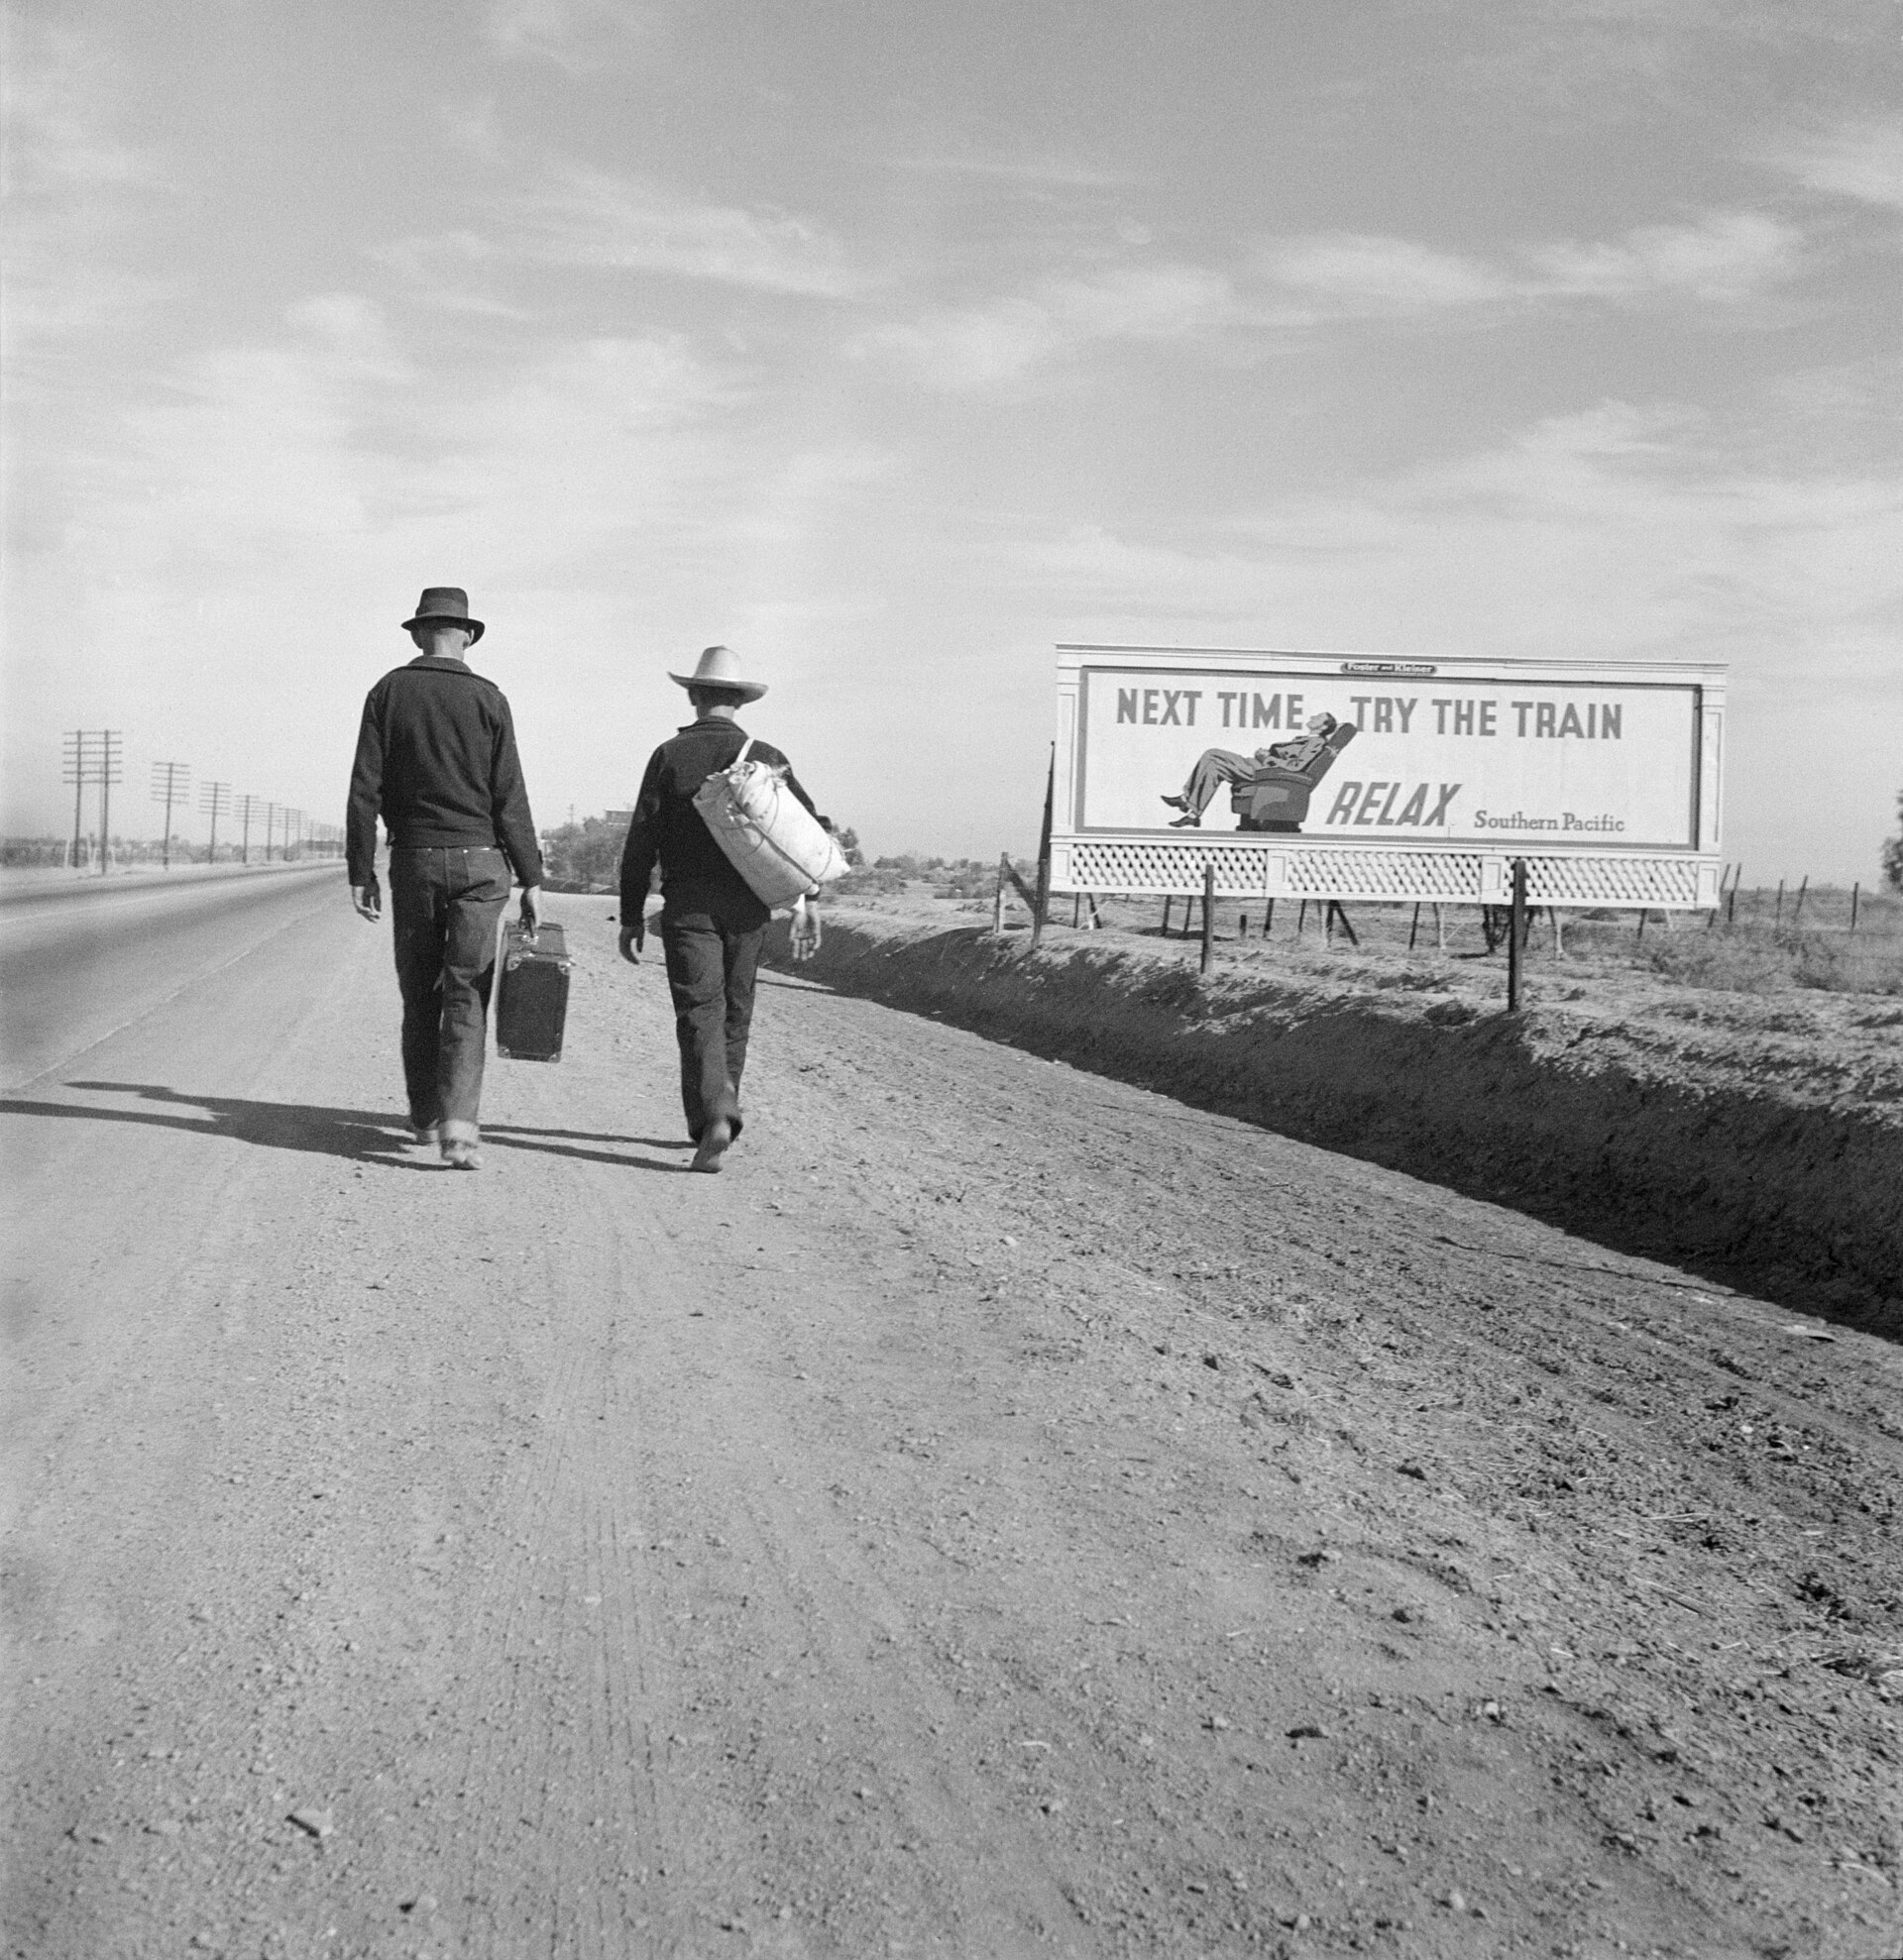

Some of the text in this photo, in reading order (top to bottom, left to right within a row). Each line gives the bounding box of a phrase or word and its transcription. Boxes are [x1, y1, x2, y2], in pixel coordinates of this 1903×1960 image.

[1347, 662, 1380, 672] Foster
[1116, 688, 1622, 739] NEXT TIME TRY THE TRAIN
[1325, 781, 1463, 826] RELAX
[1474, 810, 1625, 832] Southern Pacific
